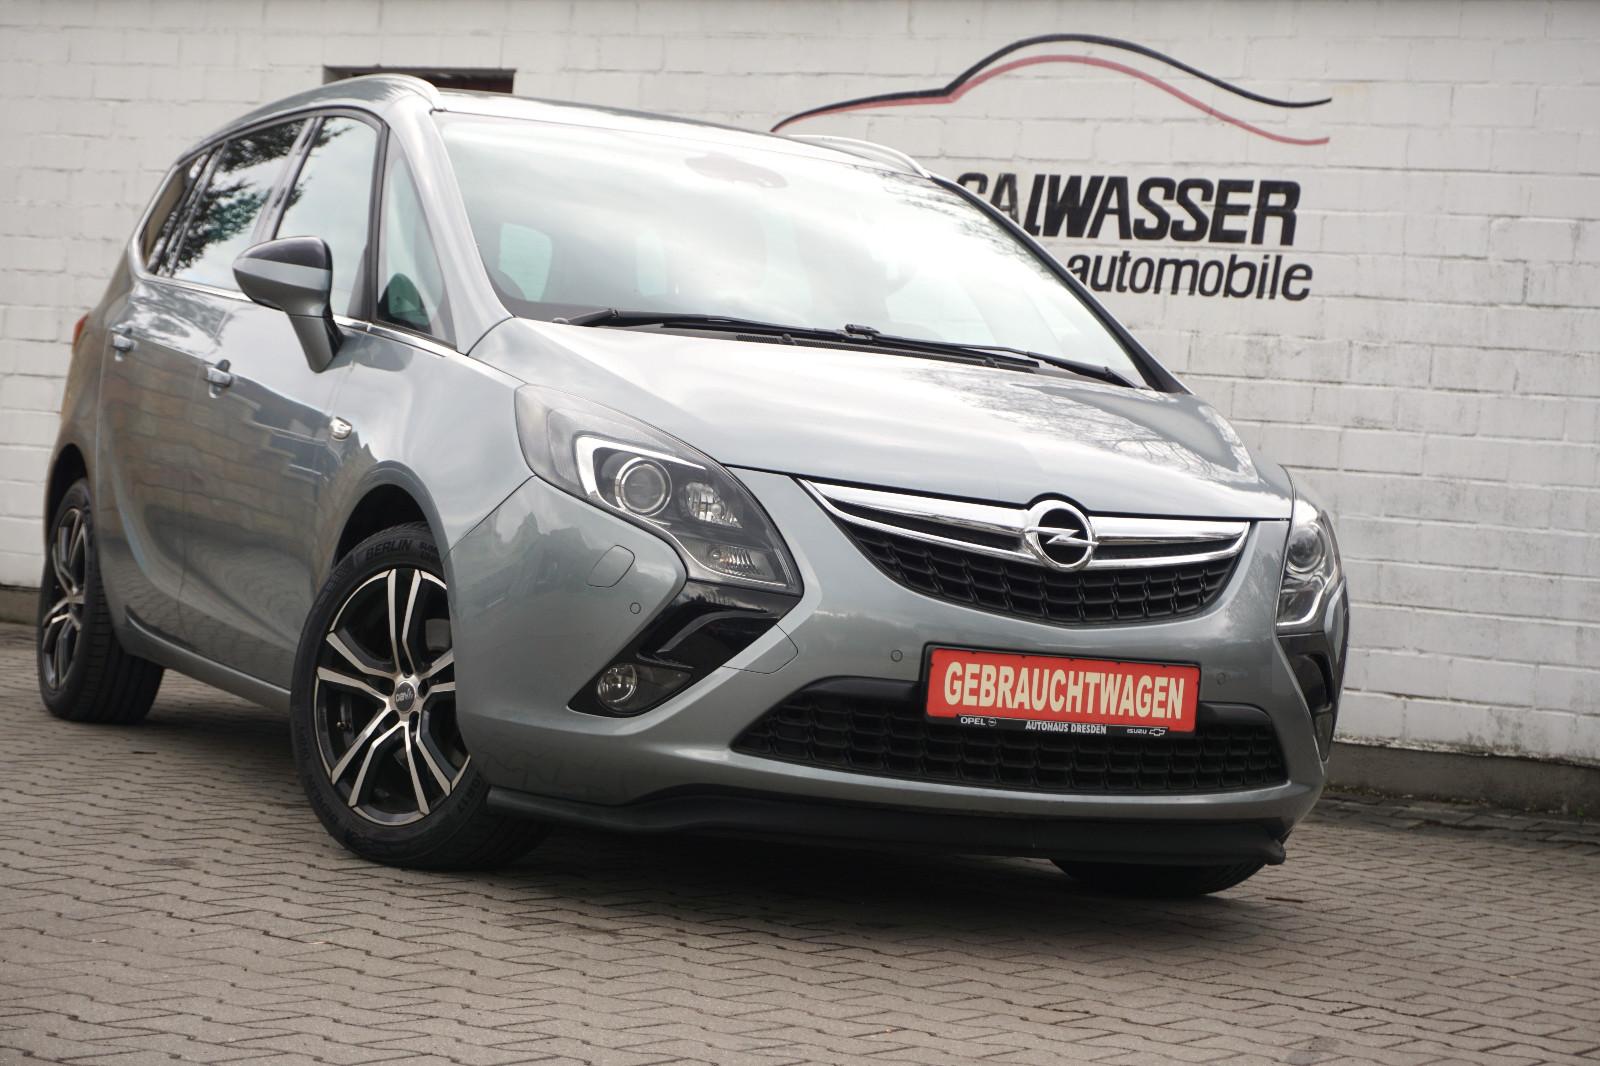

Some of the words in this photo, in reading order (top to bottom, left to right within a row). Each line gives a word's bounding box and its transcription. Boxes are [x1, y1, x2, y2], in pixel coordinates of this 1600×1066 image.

[1066, 250, 1313, 301] automobile
[944, 661, 1185, 719] GEBRAUCHTWAGEN
[960, 716, 986, 727] OPEL
[1025, 720, 1069, 732] AUTOHAUS
[1071, 722, 1107, 735] DRESDEN
